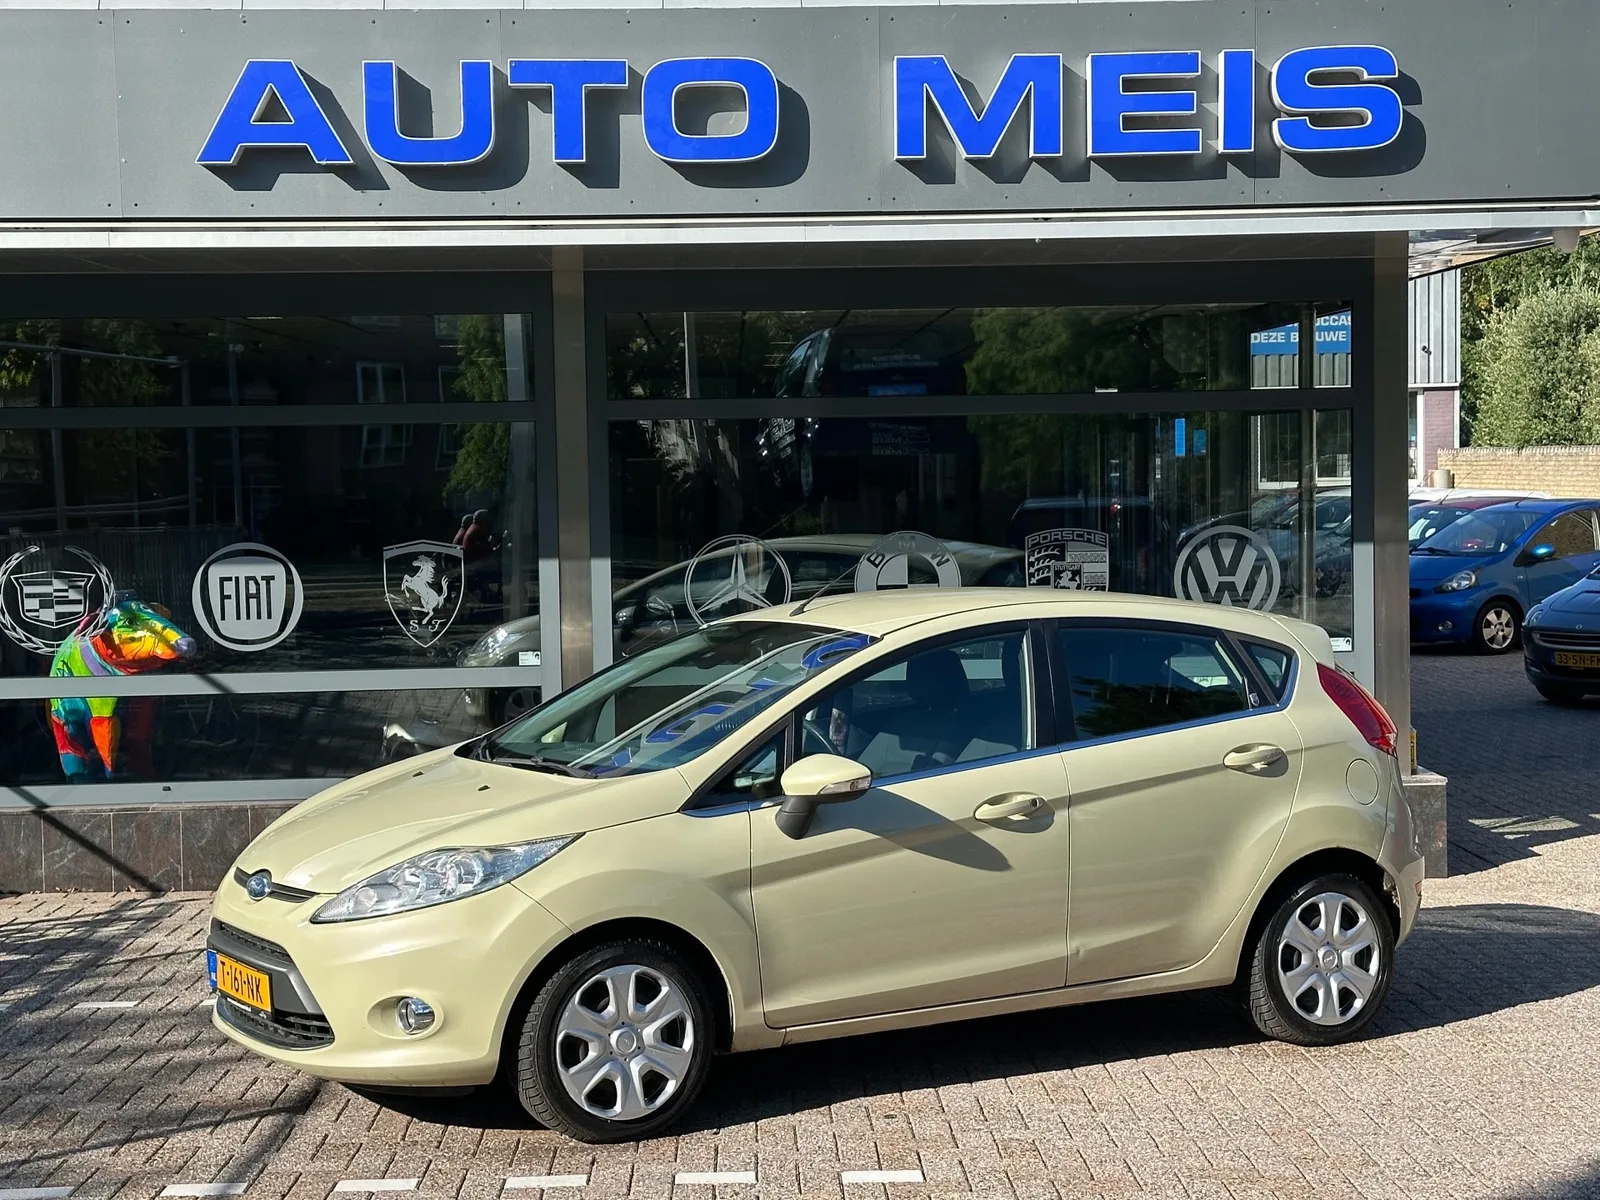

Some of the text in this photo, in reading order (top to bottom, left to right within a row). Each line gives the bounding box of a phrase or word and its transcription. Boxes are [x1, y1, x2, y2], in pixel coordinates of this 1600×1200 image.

[195, 45, 1403, 165] AUTO MEIS
[1250, 331, 1347, 343] DEZE BUWE
[1028, 531, 1106, 548] PORSCHE
[218, 575, 275, 621] FIAT
[220, 960, 263, 1004] T-161-NK
